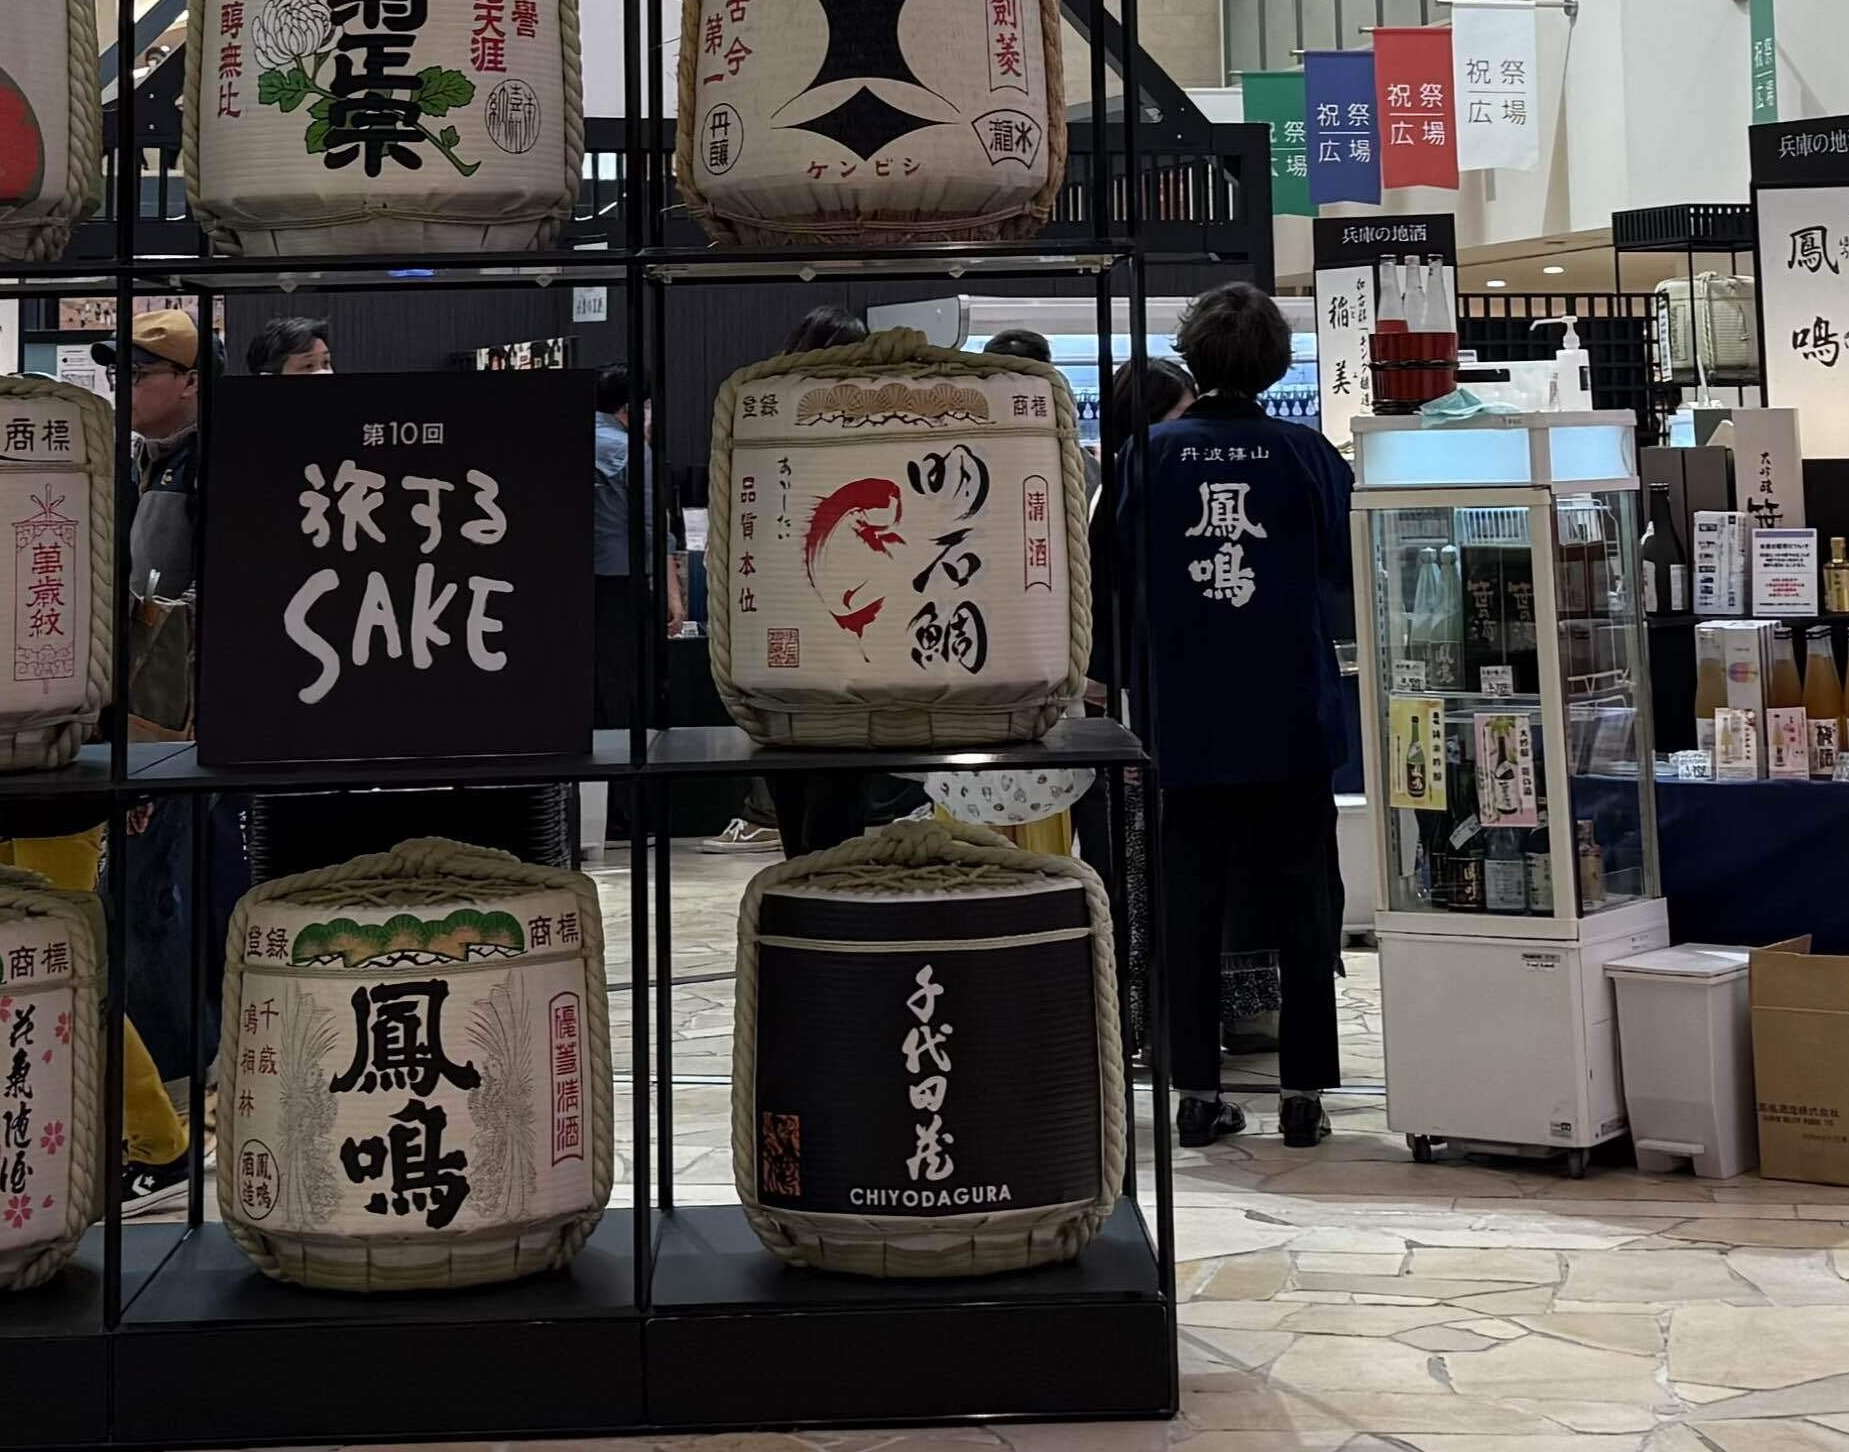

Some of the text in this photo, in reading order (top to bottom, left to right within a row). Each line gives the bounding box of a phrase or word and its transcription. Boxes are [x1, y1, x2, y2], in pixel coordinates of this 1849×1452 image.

[1466, 58, 1525, 85] 祝祭
[1388, 83, 1443, 108] 祝祭
[1317, 103, 1370, 126] 祝祭
[1468, 100, 1528, 125] 広場
[1390, 121, 1445, 145] 広場
[1318, 140, 1370, 163] 広場
[807, 157, 921, 179] ケンビシ
[1342, 225, 1427, 244] 兵庫の地酒
[1788, 225, 1840, 367] 鳳鳴
[4, 418, 71, 452] 商標
[362, 422, 444, 446] 第10回
[299, 459, 507, 554] 旅する
[1027, 491, 1048, 568] 清酒
[1185, 482, 1268, 607] 鳳鳴
[906, 443, 990, 675] 明石鯛
[284, 563, 514, 704] SAKE
[330, 978, 482, 1230] 鳳鳴
[850, 1184, 1012, 1208] CHIYODAGURA
